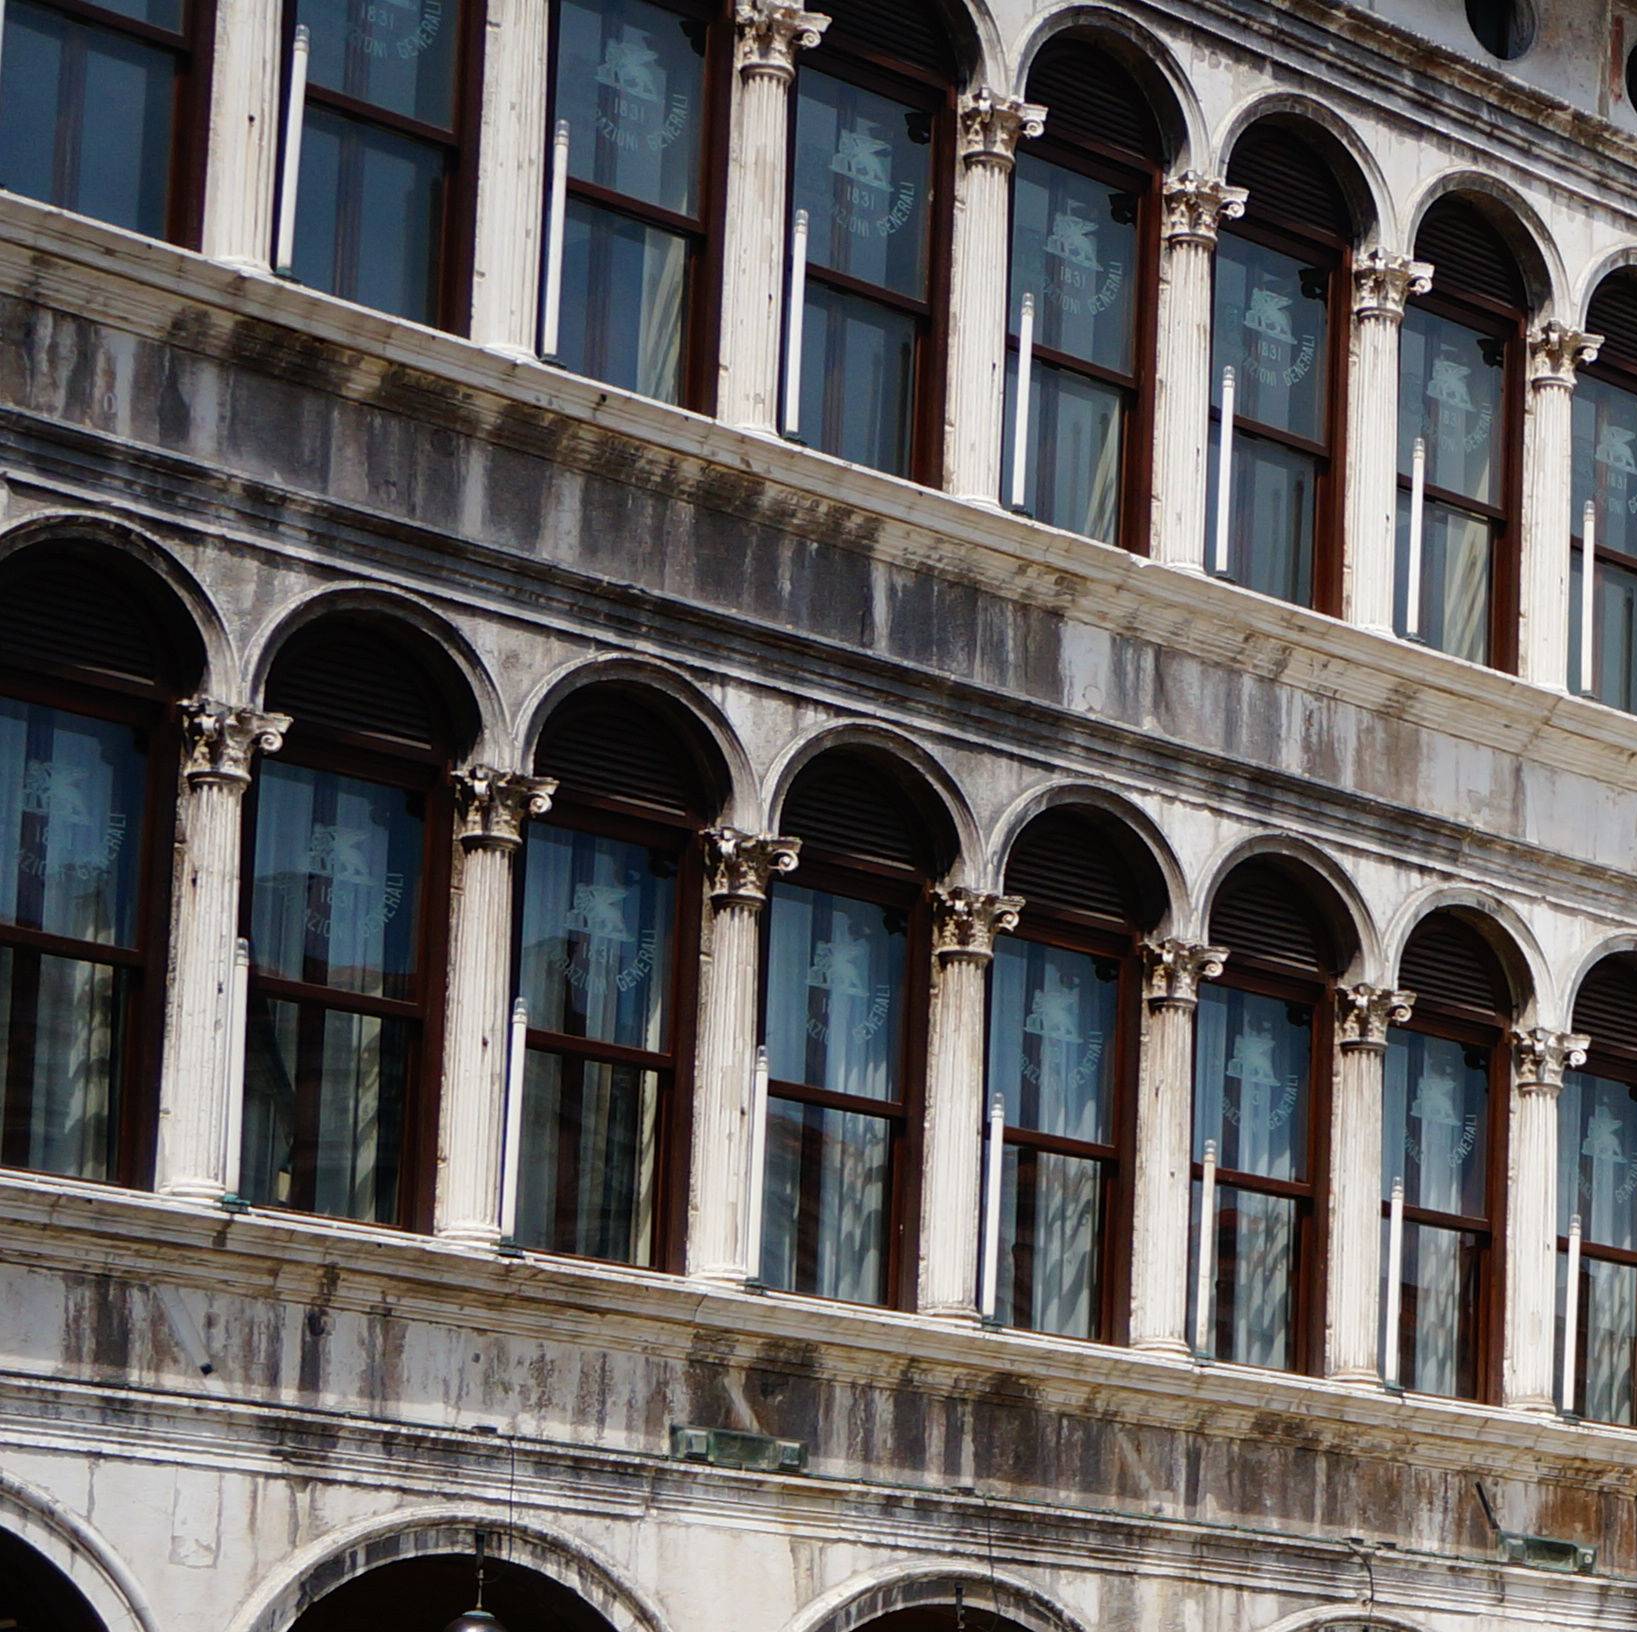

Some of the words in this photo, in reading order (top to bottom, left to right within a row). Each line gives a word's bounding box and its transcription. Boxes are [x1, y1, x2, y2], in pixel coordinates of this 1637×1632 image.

[361, 3, 394, 30] 1831
[614, 97, 644, 122] 1831
[647, 94, 688, 151] GENERALI
[847, 186, 876, 209] 1831
[876, 181, 915, 237] GENERALI
[1060, 266, 1085, 288] 1831
[1088, 261, 1122, 315] GENERALI
[1282, 334, 1315, 386] GENERALI
[615, 928, 656, 992] GENERALI
[852, 984, 890, 1044] GENERALI
[1267, 1073, 1298, 1130] GENERALI
[1448, 1113, 1477, 1168] GENERALI
